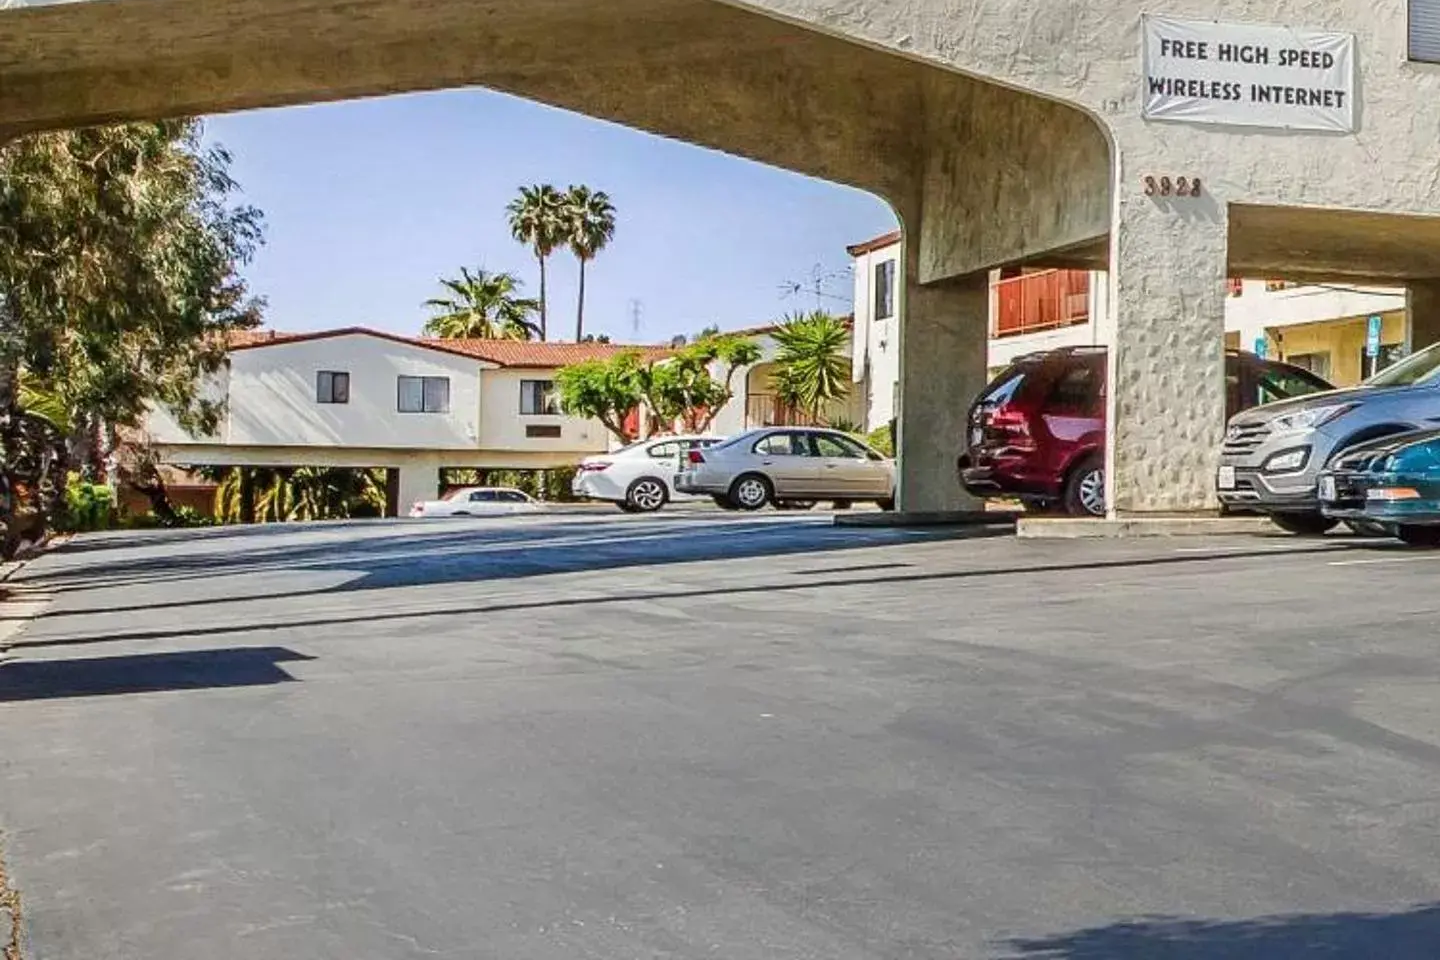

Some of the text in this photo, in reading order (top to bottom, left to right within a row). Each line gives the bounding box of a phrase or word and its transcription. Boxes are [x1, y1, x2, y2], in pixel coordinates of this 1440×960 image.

[1160, 38, 1334, 69] FREE HIGH SPEED
[1148, 76, 1345, 108] WIRELESS INTERNET
